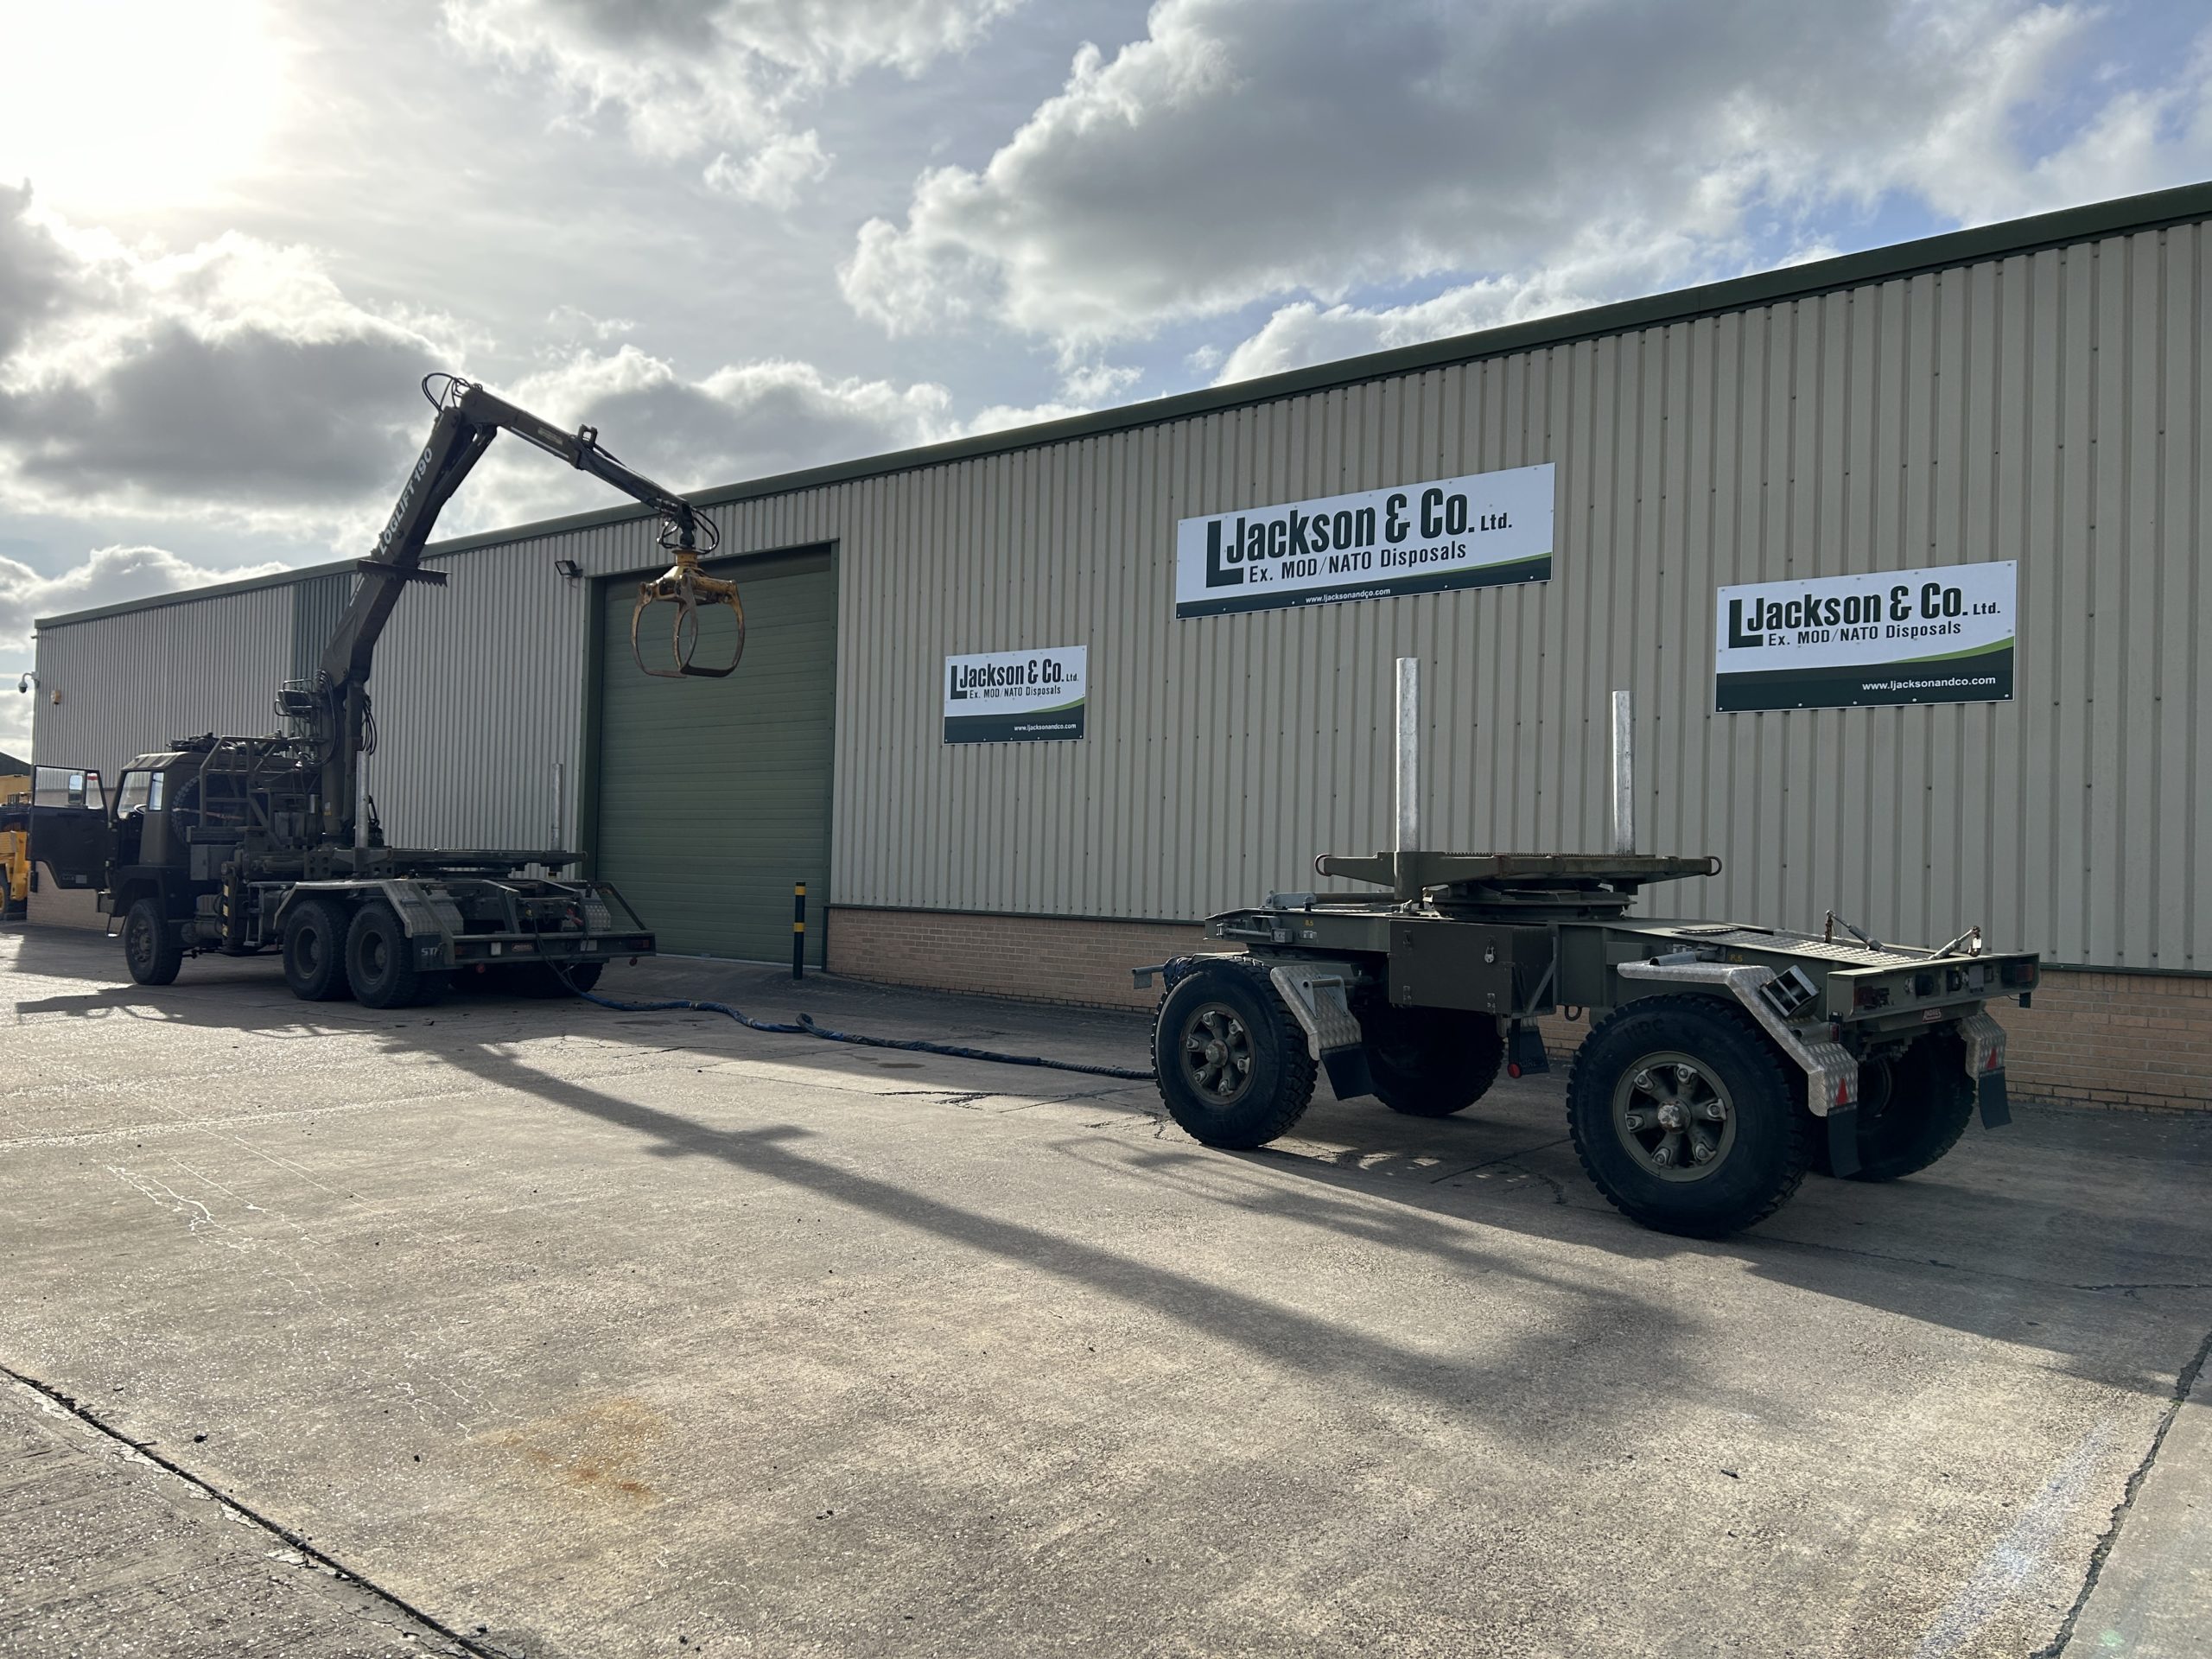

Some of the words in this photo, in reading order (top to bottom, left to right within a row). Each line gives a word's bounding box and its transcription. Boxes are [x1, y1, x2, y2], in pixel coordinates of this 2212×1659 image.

[379, 479, 415, 556] LOGLIFT
[414, 447, 433, 484] 190
[1385, 493, 1411, 543] &
[1421, 488, 1475, 538] Co.
[1480, 512, 1512, 531] Ltd.
[1249, 565, 1274, 583] Ex.
[1281, 551, 1372, 580] MOD/NATO
[1381, 540, 1466, 567] Disposals
[1305, 588, 1391, 603] www.ljacksonandco.com
[1890, 586, 1912, 621] &
[1921, 582, 1968, 620] Co.
[1973, 602, 2001, 616] Ltd.
[1768, 633, 1790, 646] Ex.
[1797, 626, 1878, 645] MOD/NATO
[1886, 620, 1961, 639] Disposals
[1027, 659, 1039, 684] &
[1042, 658, 1065, 683] Co.
[1065, 673, 1079, 683] Ltd.
[1862, 677, 1996, 691] www.ljacksonandco.com
[969, 690, 981, 699] Ex.
[1026, 685, 1061, 697] Disposals
